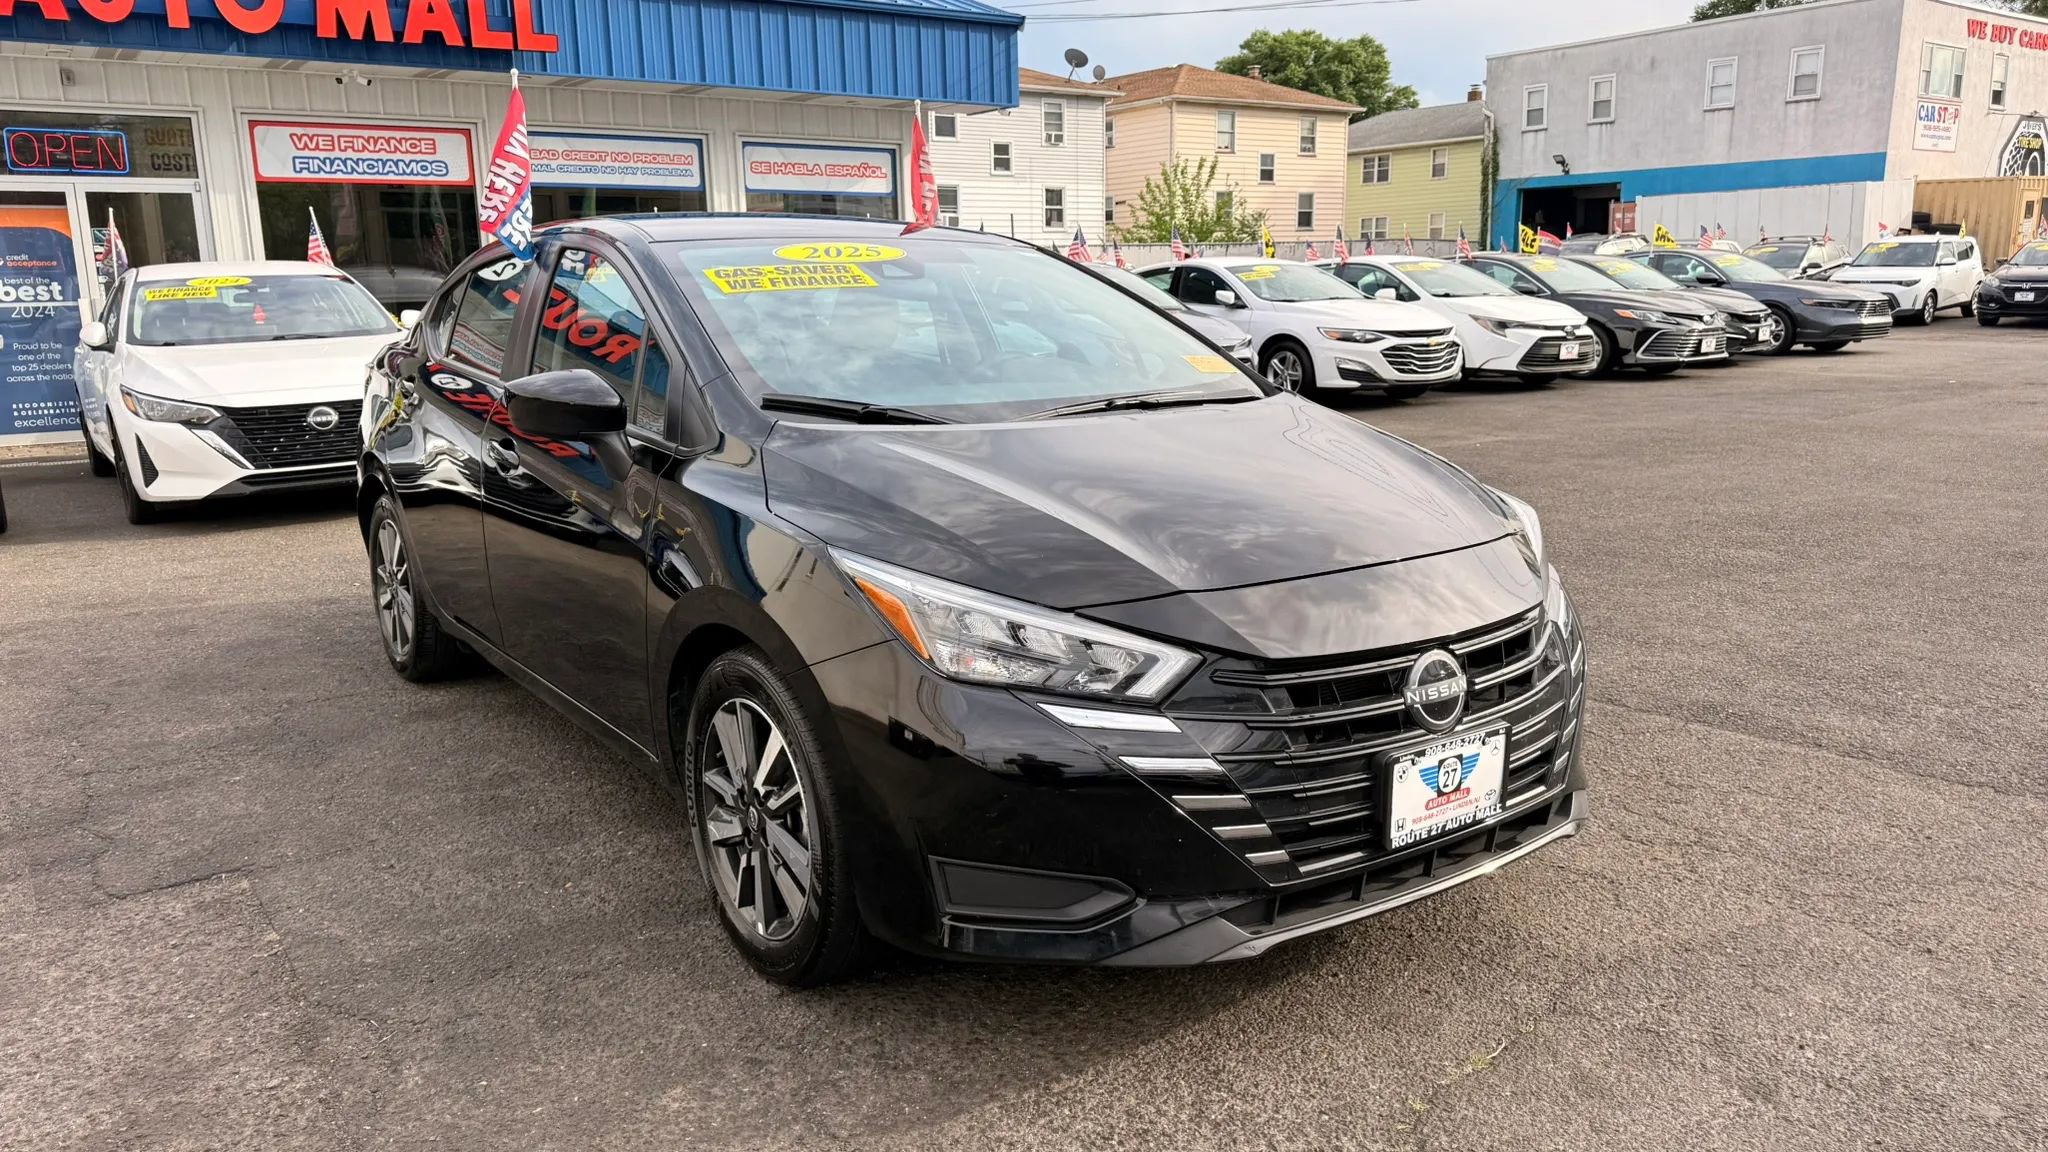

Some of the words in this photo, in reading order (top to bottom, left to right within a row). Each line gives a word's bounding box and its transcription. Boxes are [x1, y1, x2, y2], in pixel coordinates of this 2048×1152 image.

[1967, 19, 1988, 39] WE
[1990, 24, 2018, 45] BUY
[2019, 30, 2048, 51] CARS
[1919, 105, 1936, 122] CAR
[10, 132, 124, 170] OPEN
[290, 134, 334, 151] WE
[338, 135, 436, 155] FINANCE
[530, 149, 559, 161] BAD
[562, 150, 609, 162] CREDIT
[611, 151, 630, 163] NO
[633, 152, 693, 165] PROBLEM
[293, 157, 448, 177] FINANCIAMOS
[531, 164, 555, 173] MAL
[557, 164, 599, 174] CREDITO
[601, 165, 617, 175] NO
[618, 166, 639, 176] HAY
[641, 166, 693, 177] PROBLEMA
[750, 161, 773, 174] SE
[774, 162, 821, 176] HABLA
[825, 162, 887, 179] ESPAÑOL
[802, 246, 881, 259] 2025
[7, 260, 57, 268] acceptance
[4, 277, 23, 285] best
[25, 276, 34, 284] of
[36, 276, 50, 284] the
[726, 278, 764, 290] WE
[770, 276, 864, 288] FINANCE
[0, 281, 63, 302] best
[11, 305, 55, 318] 2024
[47, 352, 61, 360] the
[40, 362, 72, 370] dealers
[6, 375, 35, 383] across
[37, 373, 51, 381] the
[1406, 676, 1467, 704] NISSAN
[1425, 733, 1485, 757] 908-648-2727
[686, 742, 697, 827] KUMHO
[1443, 769, 1457, 789] 27
[1427, 796, 1448, 809] AUTO
[1449, 790, 1467, 802] MALL
[1392, 829, 1428, 849] ROUTE
[1430, 823, 1445, 837] 27
[1445, 814, 1474, 831] AUTO
[1475, 803, 1503, 821] MALL
